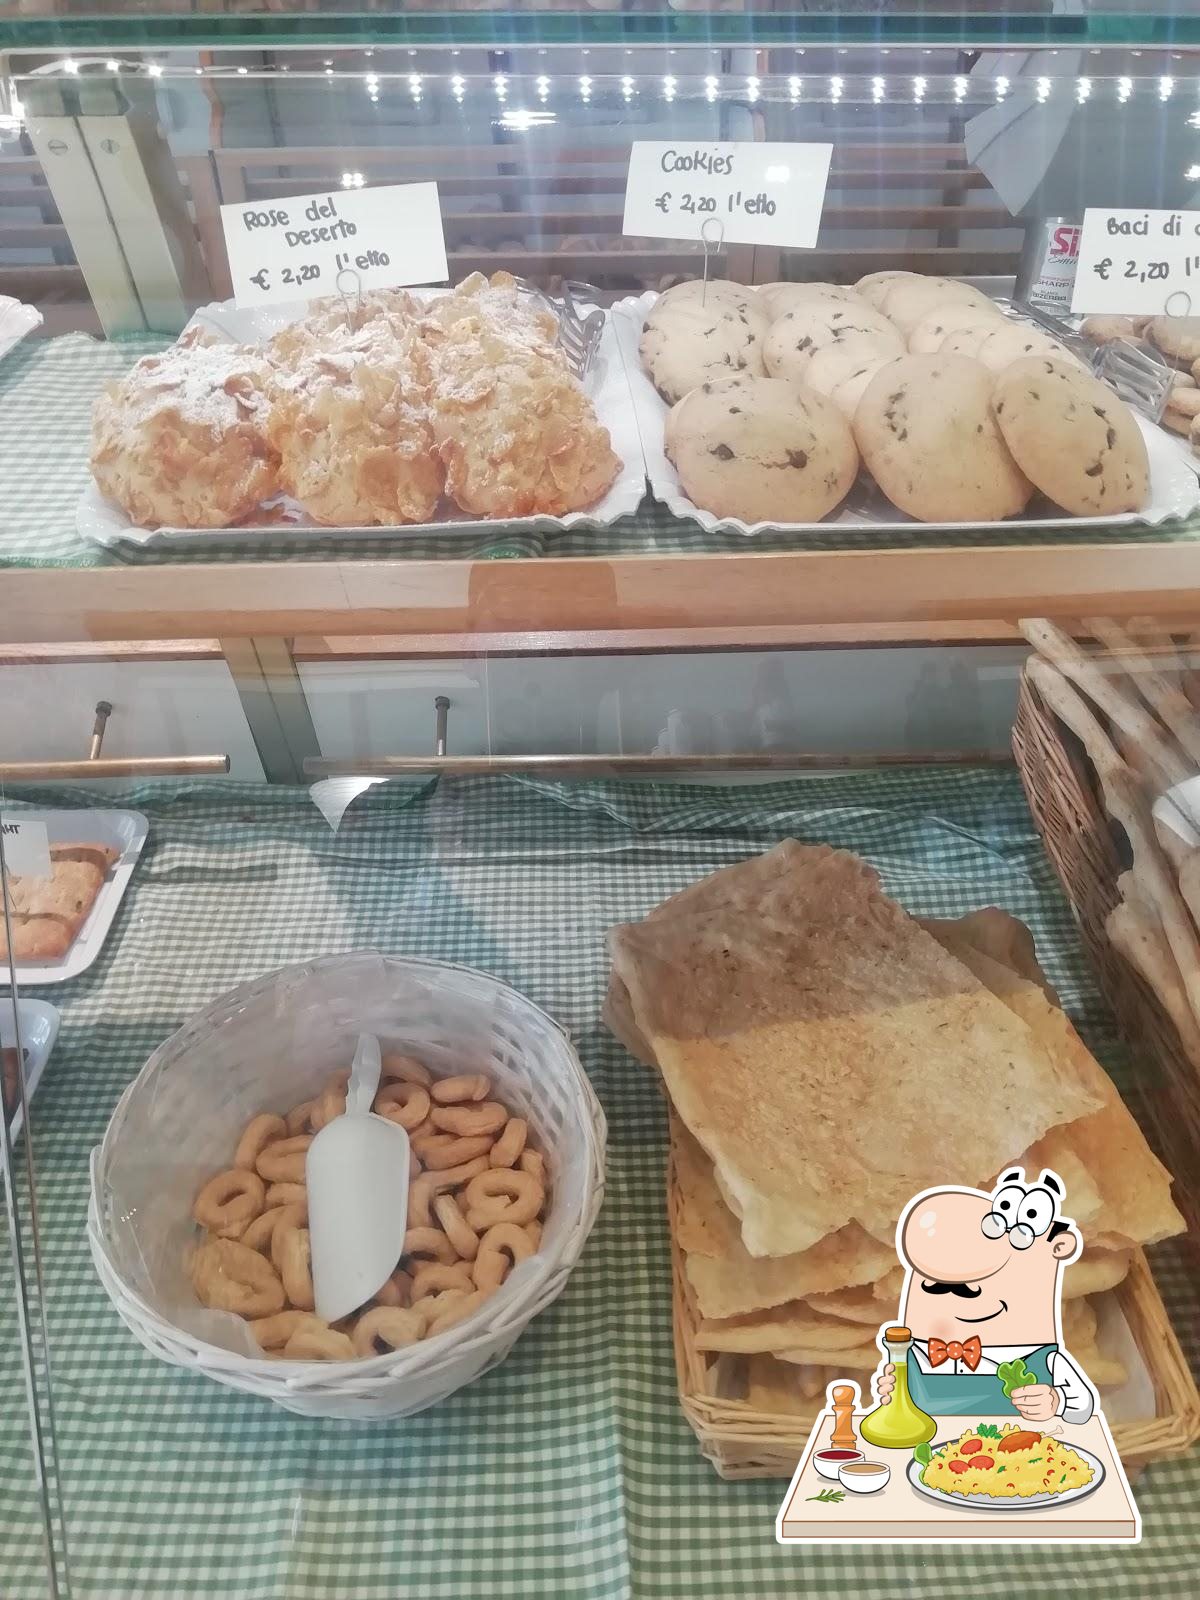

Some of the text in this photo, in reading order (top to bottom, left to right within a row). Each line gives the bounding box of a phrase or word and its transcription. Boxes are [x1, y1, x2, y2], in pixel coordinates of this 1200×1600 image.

[661, 148, 734, 175] Cookies
[243, 197, 337, 231] Rose del
[655, 192, 672, 213] €
[680, 194, 717, 214] 2,20
[285, 219, 357, 247] Deserto
[1107, 214, 1149, 235] Baci
[1163, 214, 1182, 236] di
[250, 268, 270, 290] €
[281, 265, 320, 285] 2,20
[1093, 258, 1112, 280] €
[1124, 260, 1169, 283] 2,20
